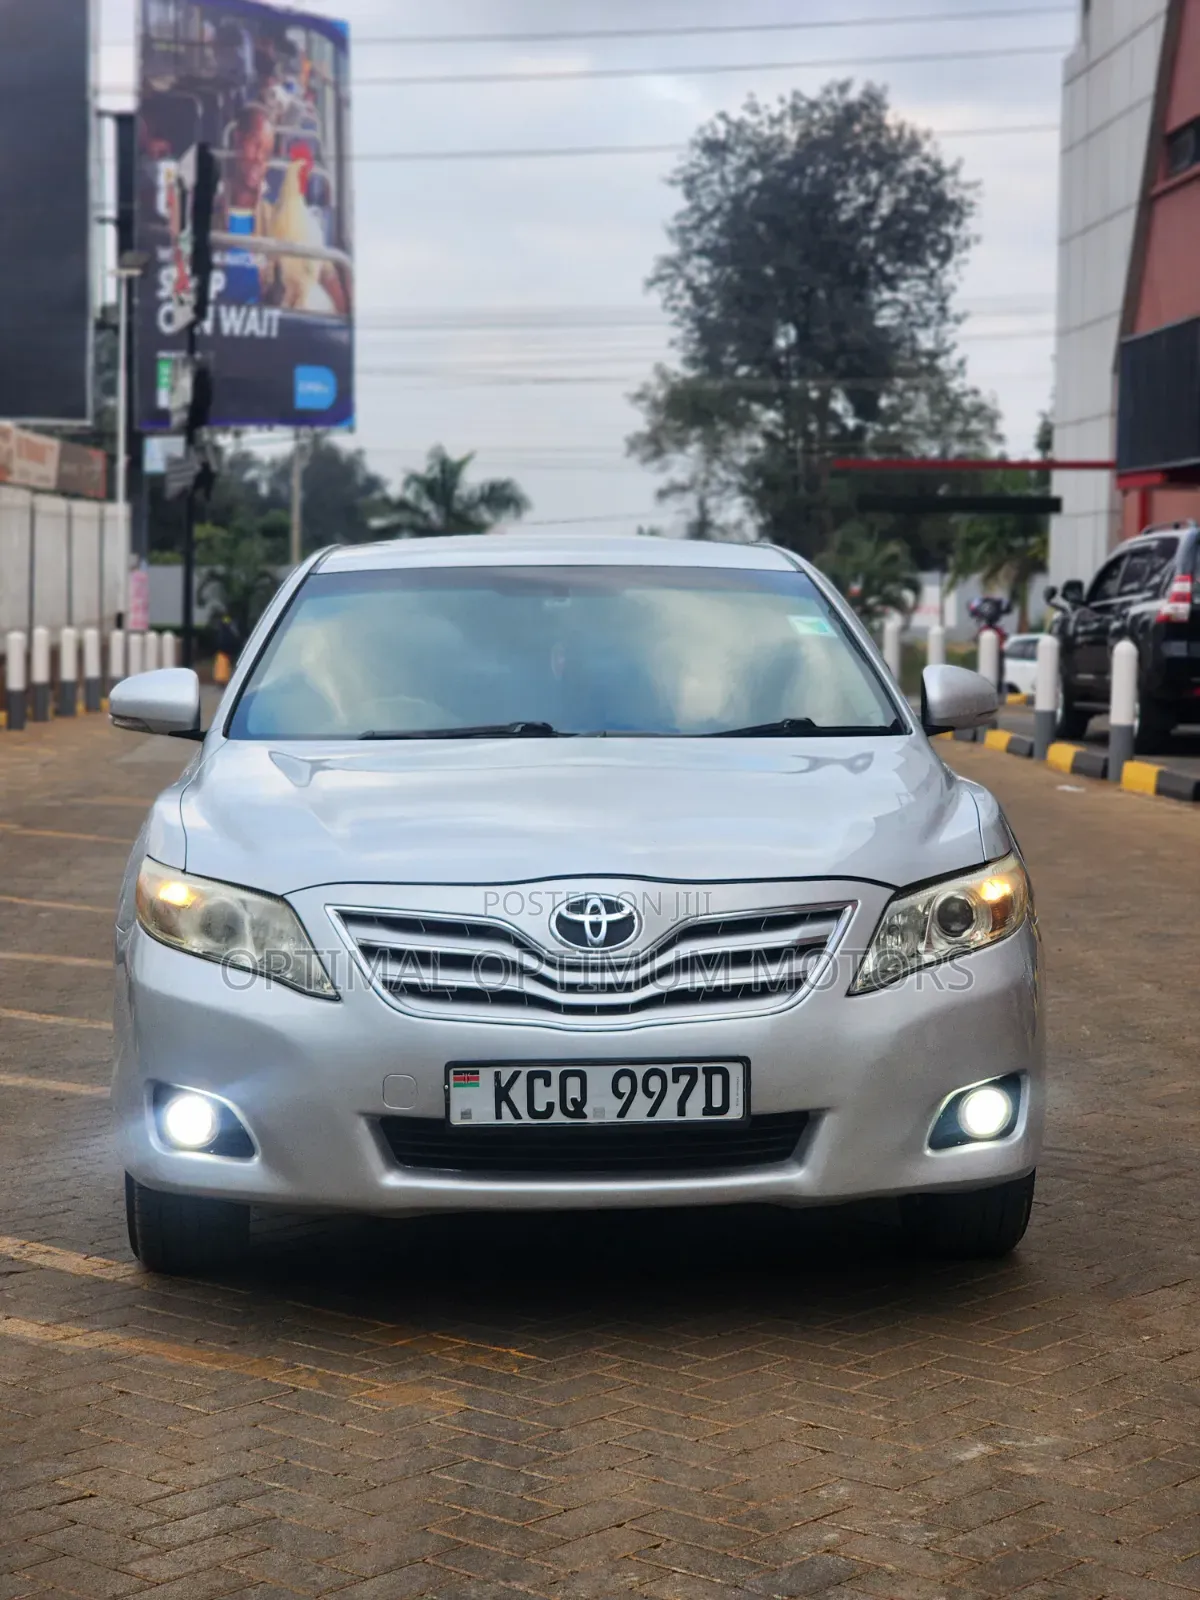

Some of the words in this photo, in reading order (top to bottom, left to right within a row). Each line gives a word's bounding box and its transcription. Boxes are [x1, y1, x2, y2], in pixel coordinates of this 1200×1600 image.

[219, 305, 282, 337] WAIT
[494, 1069, 588, 1120] KCQ
[611, 1066, 731, 1118] 997D
